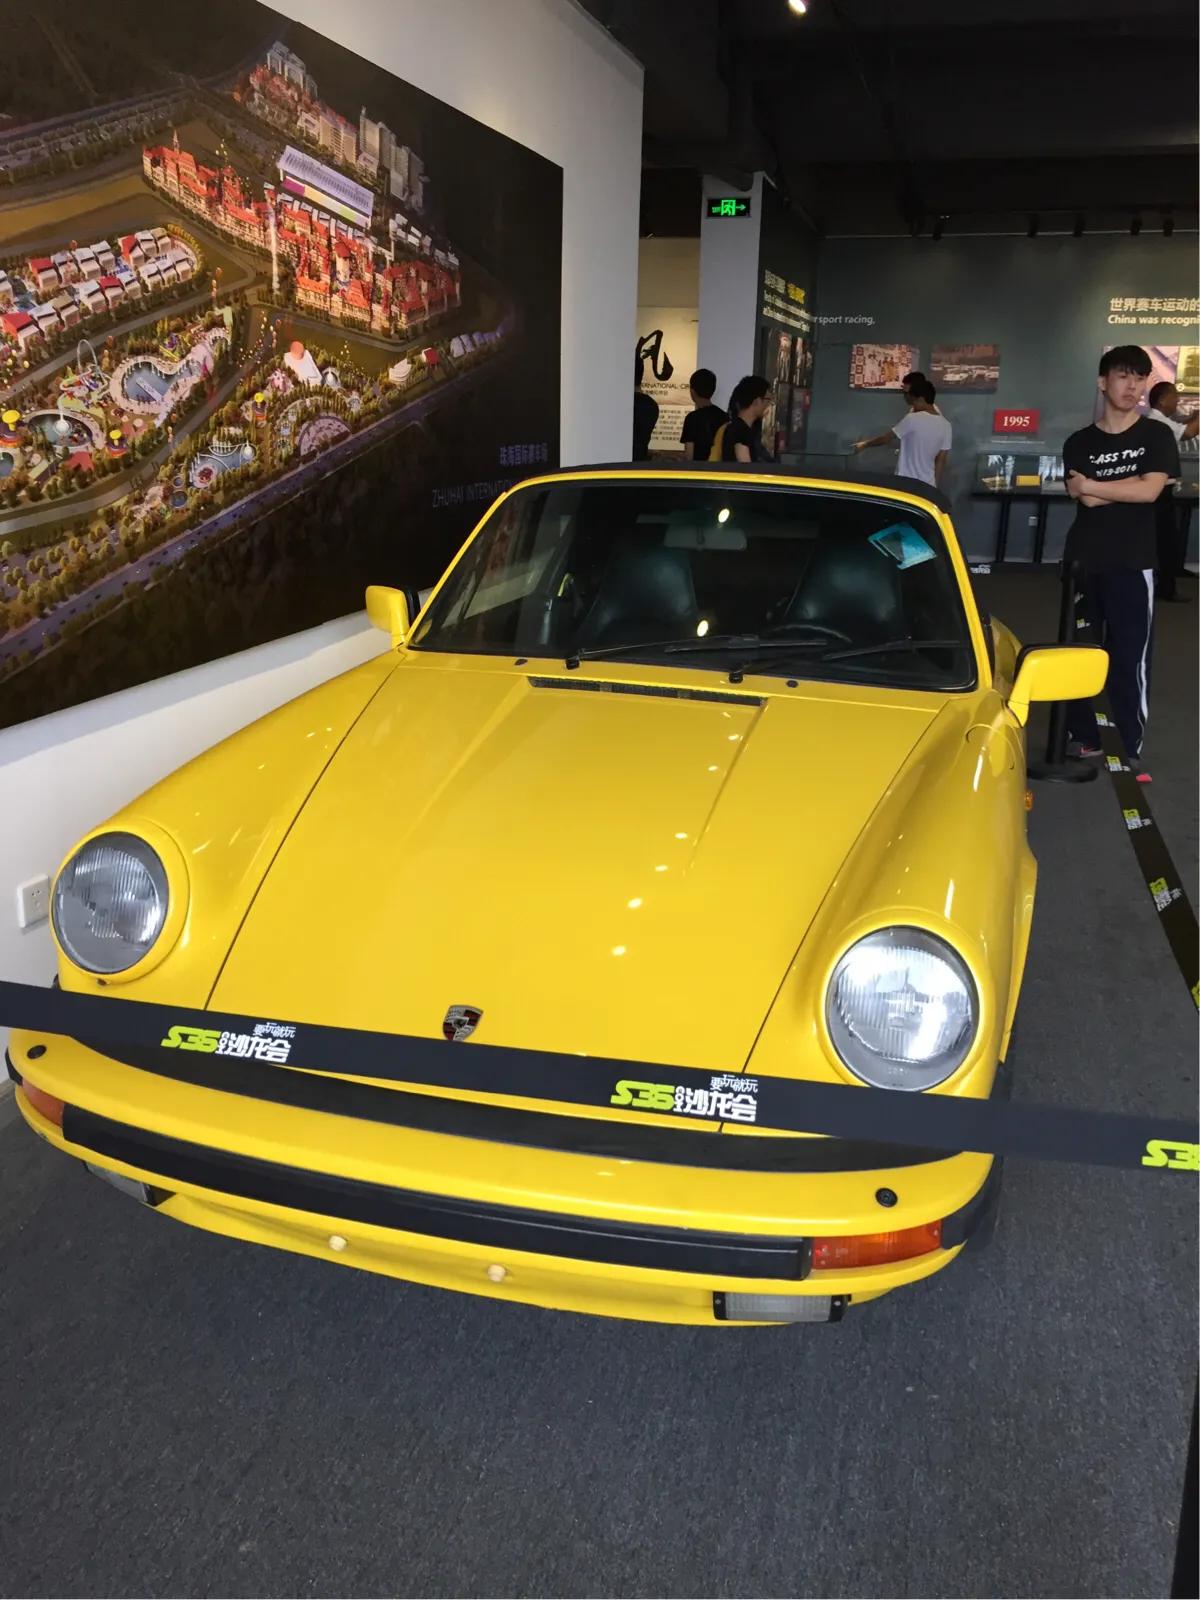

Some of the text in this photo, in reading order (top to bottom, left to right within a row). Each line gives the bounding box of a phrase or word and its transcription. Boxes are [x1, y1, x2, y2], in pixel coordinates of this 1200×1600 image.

[1107, 314, 1136, 324] China
[1138, 316, 1160, 325] was
[1003, 415, 1031, 427] 1995
[160, 1025, 221, 1053] S36
[253, 1022, 296, 1038] 要玩就玩
[710, 1074, 758, 1093] 要玩就玩
[610, 1079, 675, 1110] S36
[1141, 1139, 1199, 1171] S3
